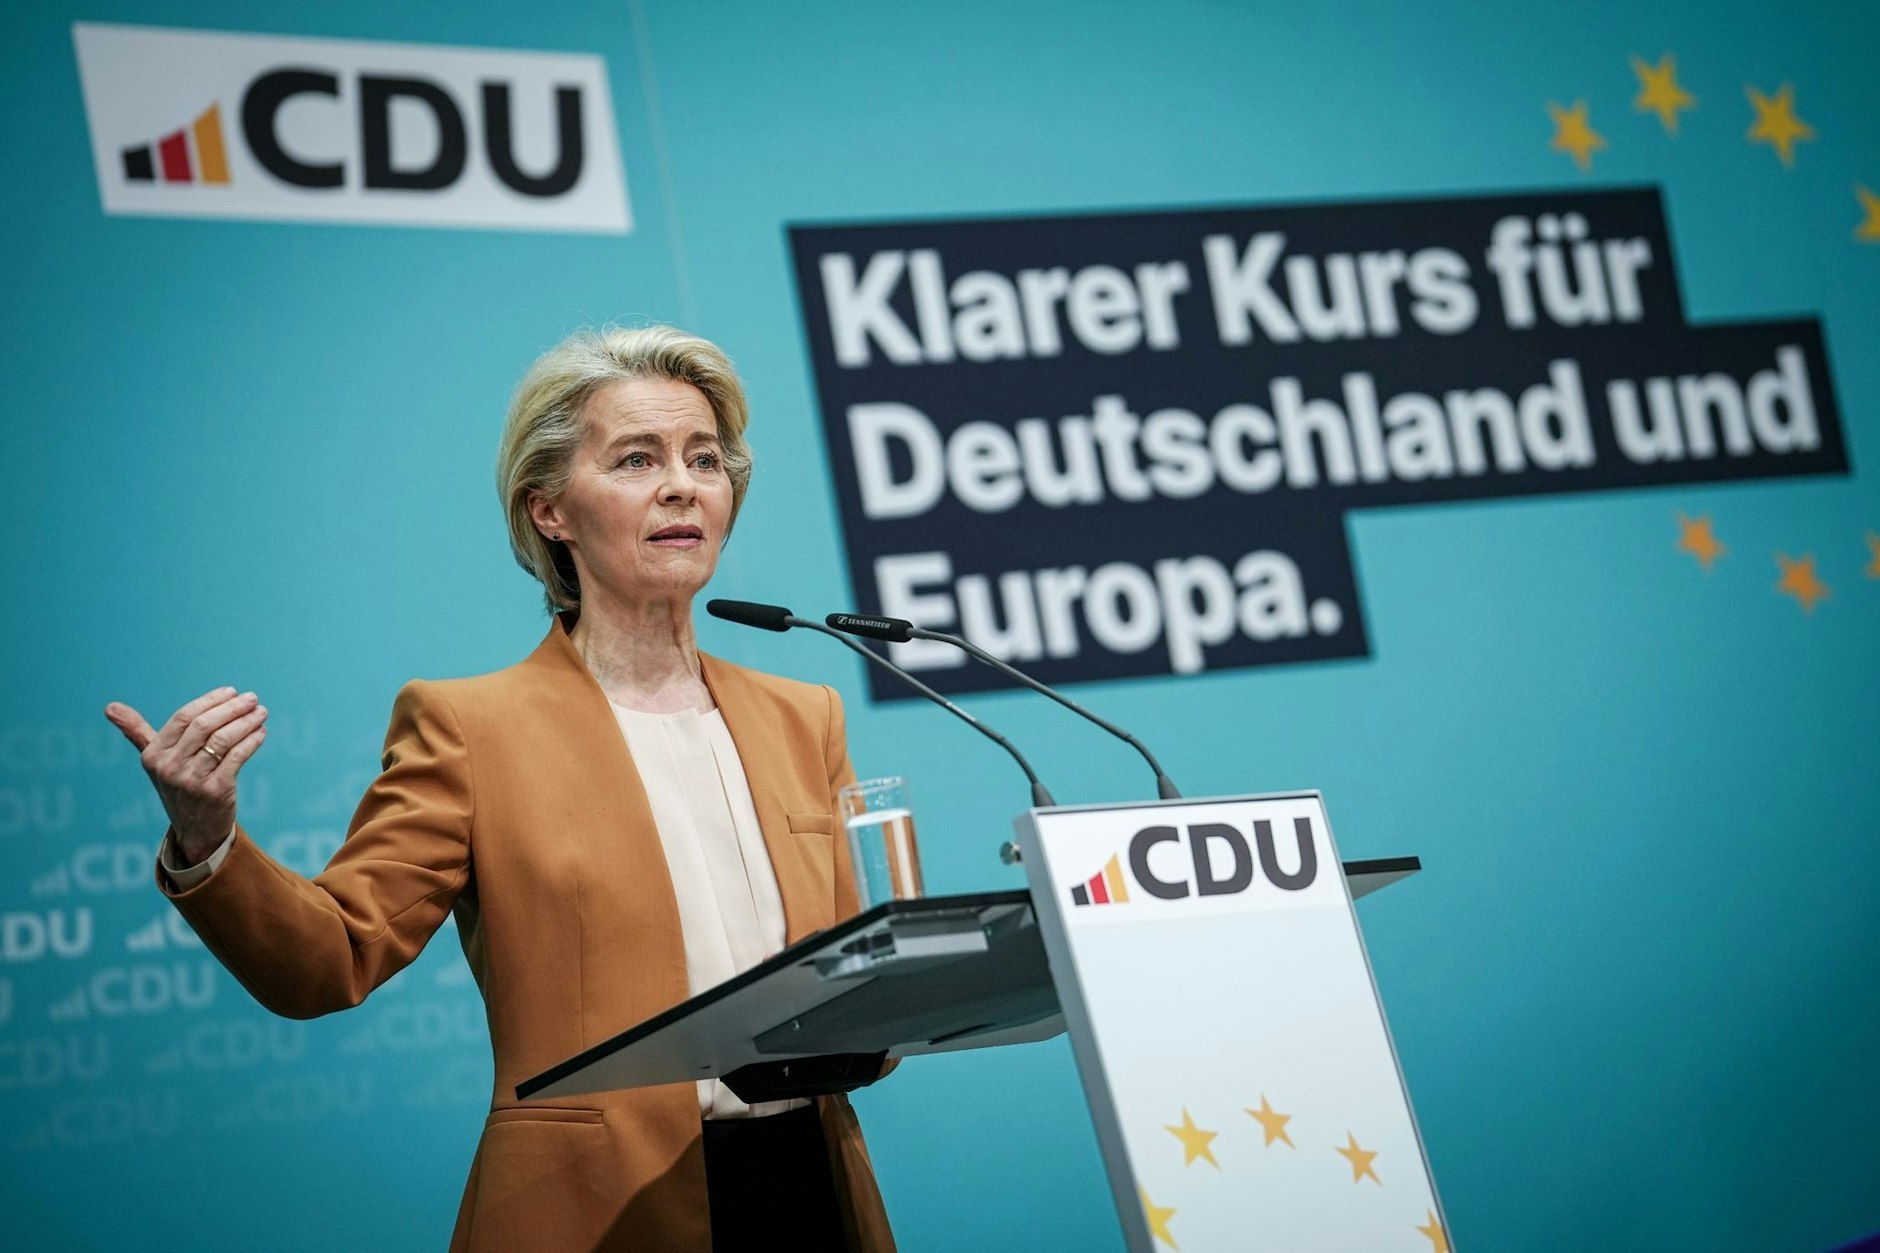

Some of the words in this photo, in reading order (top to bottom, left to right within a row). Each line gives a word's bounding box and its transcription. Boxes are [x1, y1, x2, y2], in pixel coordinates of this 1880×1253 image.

[239, 66, 585, 198] CDU
[819, 248, 1191, 368] Klarer
[1202, 231, 1480, 346] Kurs
[1485, 211, 1654, 329] für
[846, 357, 1599, 521] Deutschland
[1605, 344, 1823, 463] und
[847, 617, 891, 629] SENNHEISER
[873, 550, 1342, 676] Europa.
[72, 843, 156, 892] CD
[1128, 816, 1319, 900] CDU
[0, 907, 94, 962] DU
[90, 958, 217, 1016] CDU
